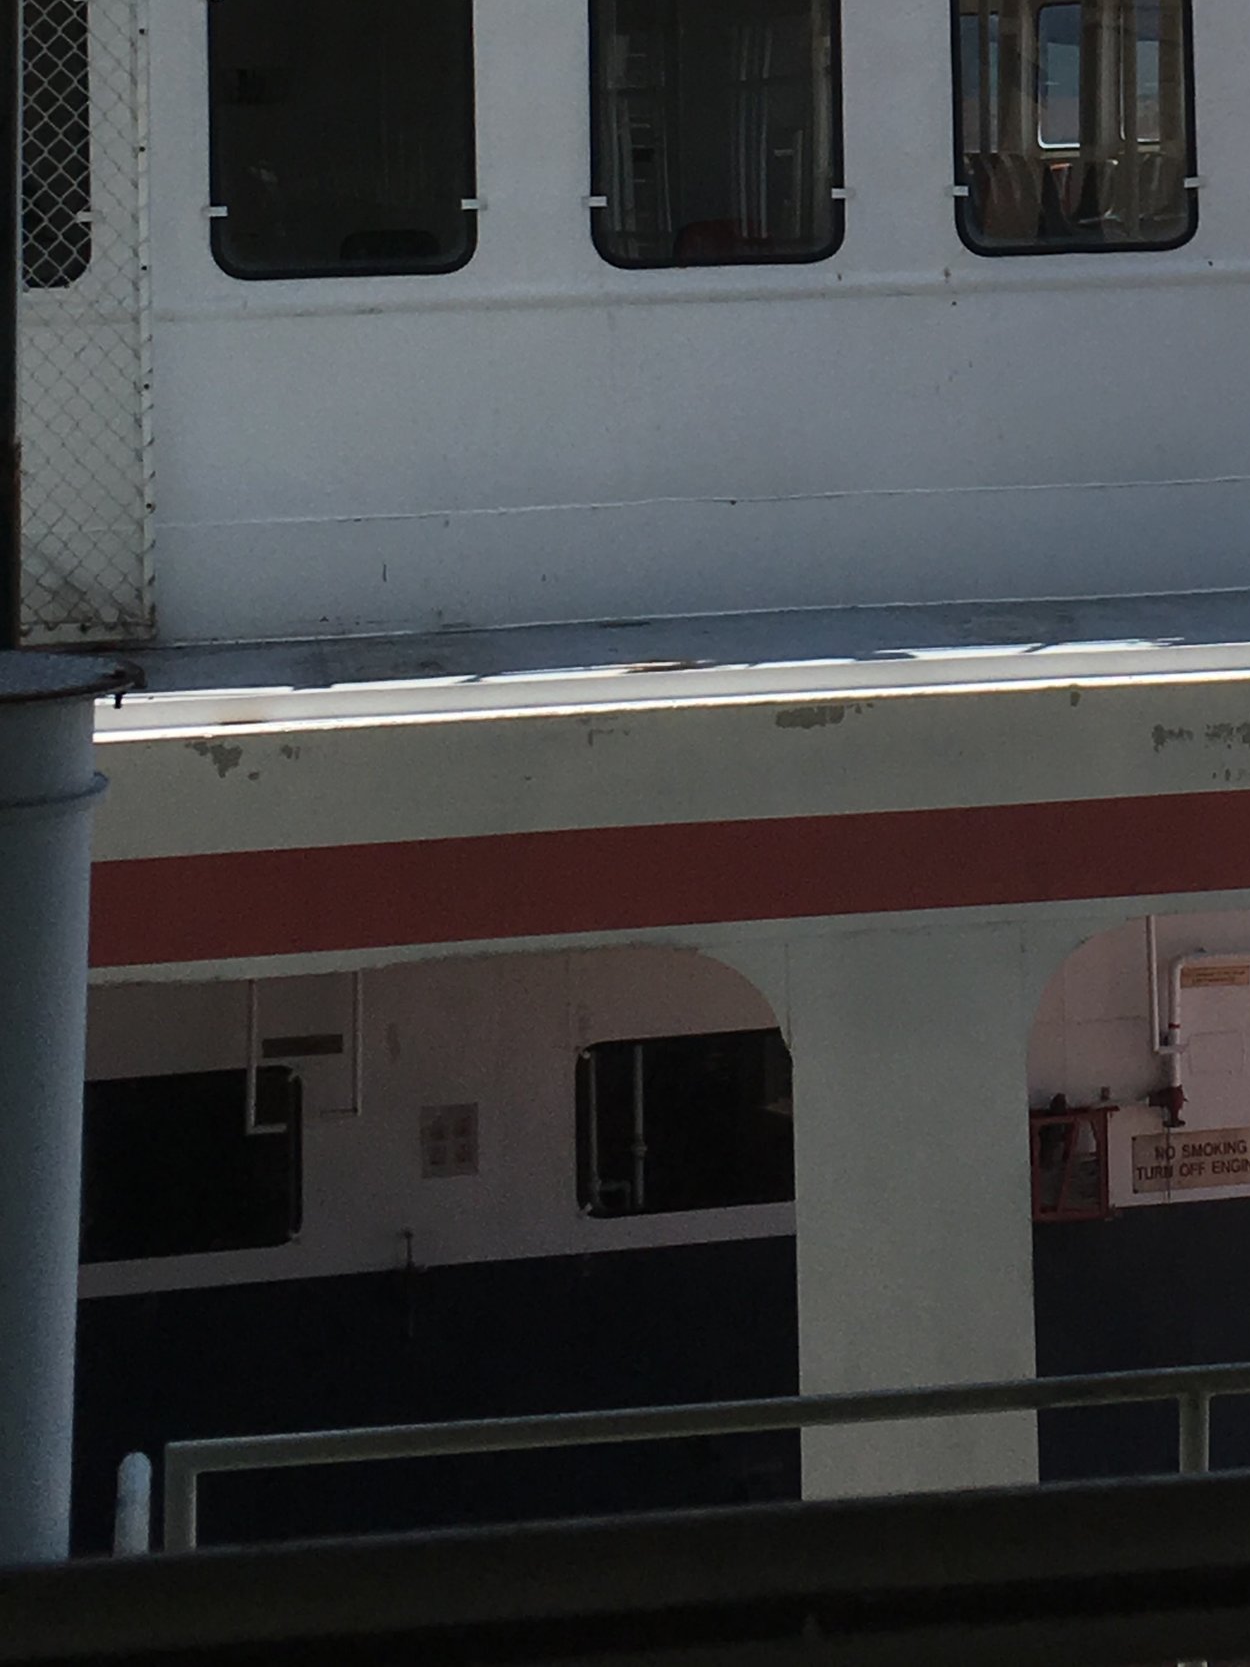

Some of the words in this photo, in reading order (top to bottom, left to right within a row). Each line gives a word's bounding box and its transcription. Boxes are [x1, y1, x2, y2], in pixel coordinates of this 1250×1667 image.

[1154, 1145, 1176, 1160] NO
[1182, 1139, 1248, 1159] SMOKING
[1136, 1165, 1174, 1181] TURN
[1179, 1161, 1205, 1177] OFF
